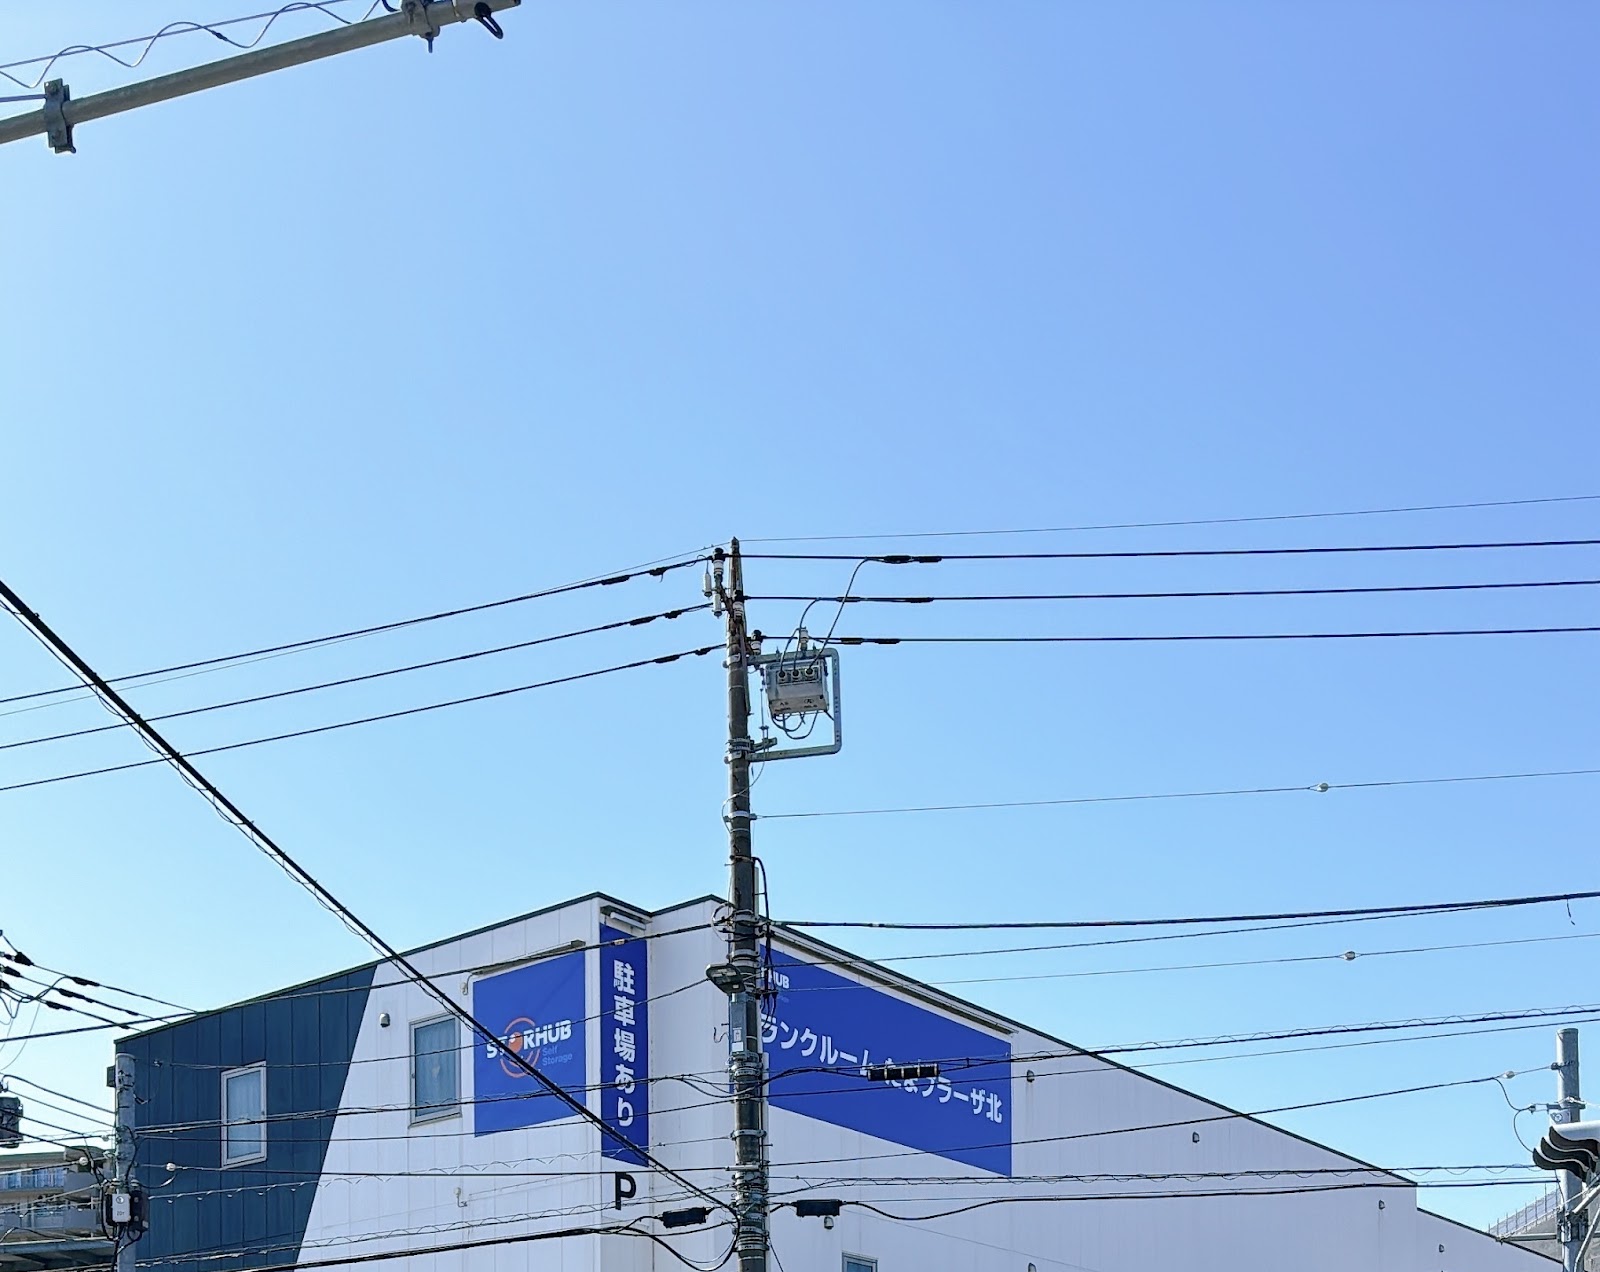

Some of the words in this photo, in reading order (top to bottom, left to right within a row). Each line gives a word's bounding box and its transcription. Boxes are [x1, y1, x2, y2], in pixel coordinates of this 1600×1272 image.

[613, 959, 636, 1127] 駐車場あり
[761, 1012, 876, 1077] ランクルー
[615, 1172, 636, 1211] P
